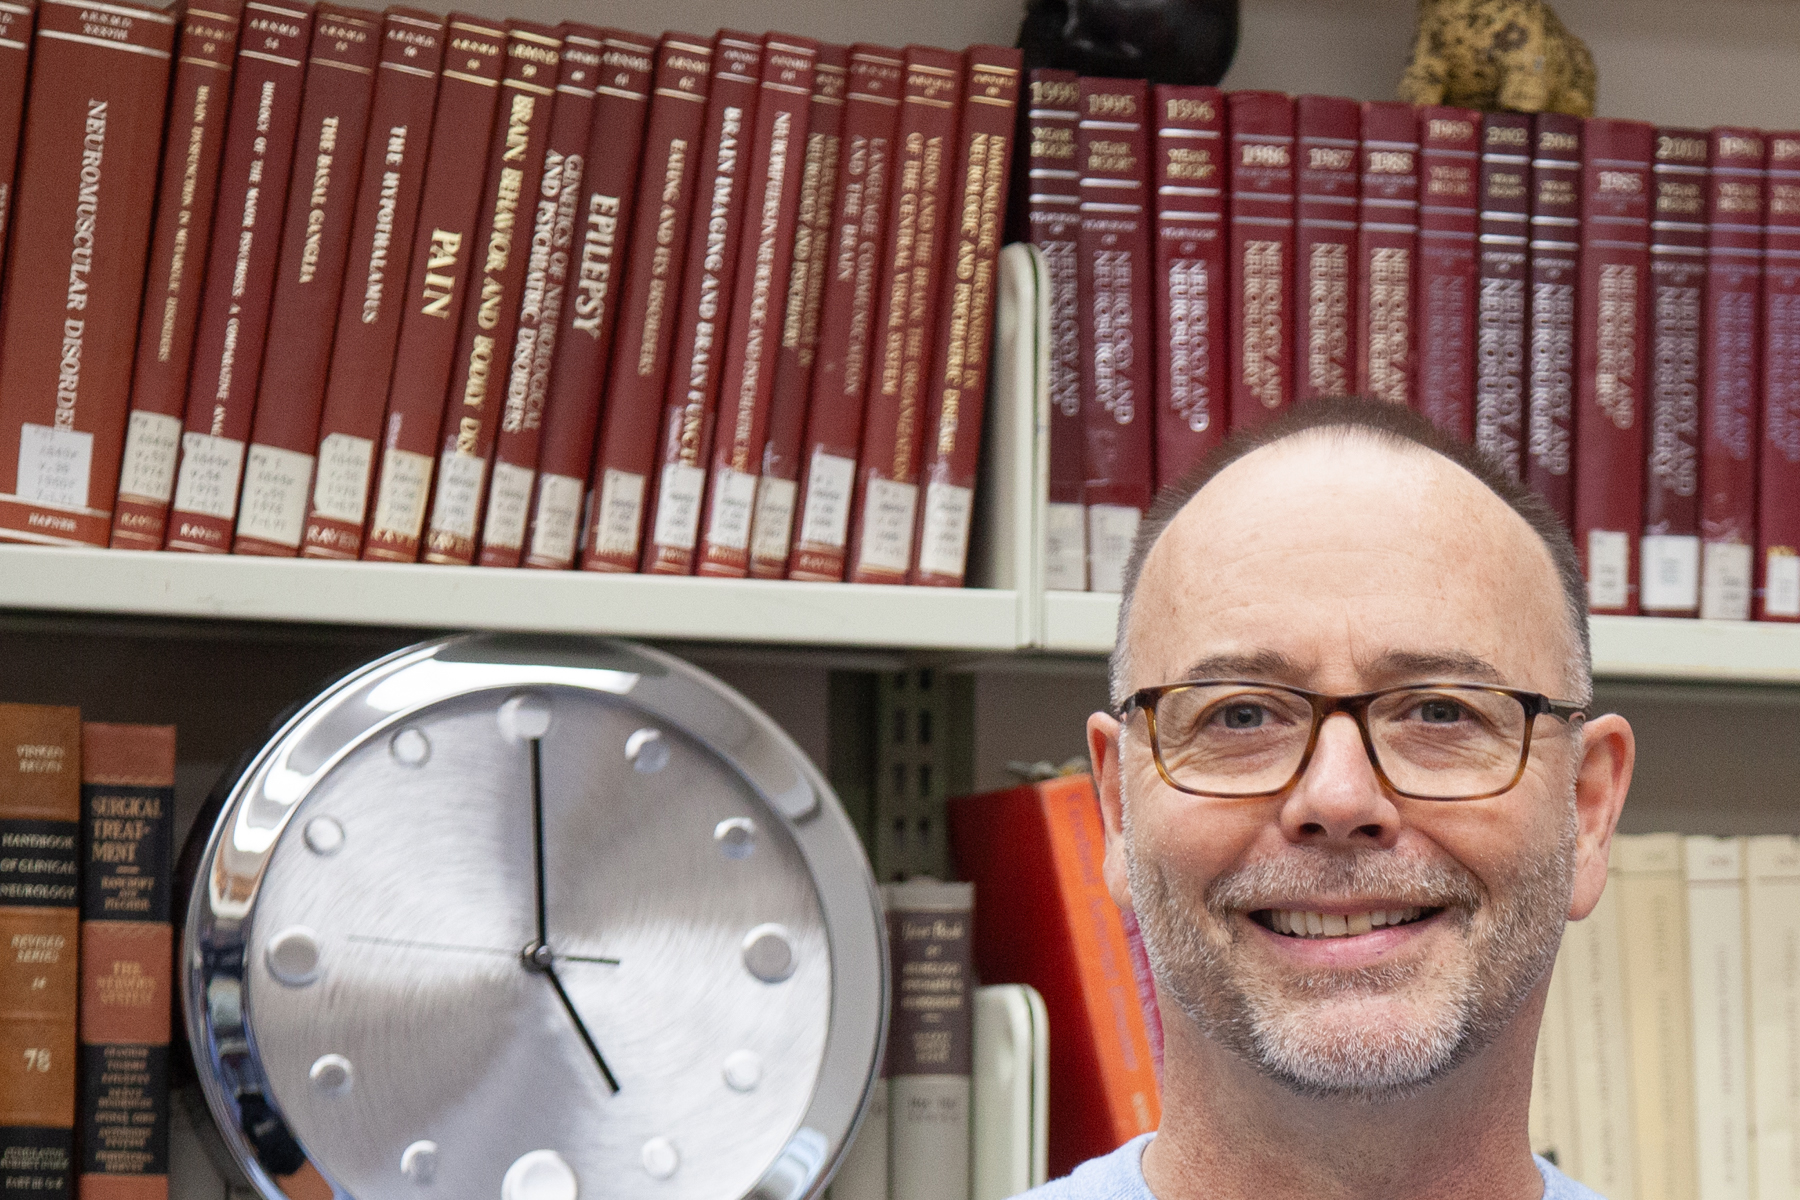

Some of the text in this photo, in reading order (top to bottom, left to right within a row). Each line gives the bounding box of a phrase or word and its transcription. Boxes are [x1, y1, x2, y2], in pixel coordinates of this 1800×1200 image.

[318, 115, 340, 153] THE
[385, 125, 408, 166] THE
[501, 93, 536, 162] BRAIN
[716, 105, 743, 173] BRAIN
[905, 131, 925, 156] OF
[66, 97, 108, 311] NEUROMUSCULAR
[540, 148, 566, 198] AND
[655, 203, 676, 245] AND
[703, 176, 734, 272] IMAGING
[836, 133, 868, 284] AND THE BRAIN
[421, 227, 463, 320] PAIN
[572, 193, 621, 340] EPILEPSY
[955, 240, 977, 280] AND
[476, 274, 505, 330] AND
[698, 273, 721, 320] AND
[1058, 241, 1081, 367] NEUROLOGY
[1093, 251, 1116, 402] NEUROSURGERY
[1260, 241, 1283, 409] NEUROLOGY AND
[1326, 243, 1348, 396] NEUROLOGY AN
[1386, 248, 1409, 366] NEUROLOGY
[1615, 265, 1638, 380] NEUROLOGY
[689, 321, 715, 388] BRAIN
[1111, 251, 1135, 425] NEUROLOGY AND
[1168, 259, 1192, 409] NEUROSURGERY
[1186, 259, 1211, 432] NEUROLOGY AND
[1499, 278, 1525, 485] NEUROLOGY AND
[1550, 284, 1575, 476] NEUROLOGY AND
[1674, 286, 1700, 496] NEUROLOGY AND
[306, 523, 360, 549] RAVEN
[1, 832, 75, 850] HANDBOOK
[91, 795, 163, 820] SURGICAL
[92, 817, 151, 841] TREAT-
[0, 857, 78, 876] OF CLINICAL
[92, 840, 139, 864] MENT
[23, 1046, 52, 1073] 78
